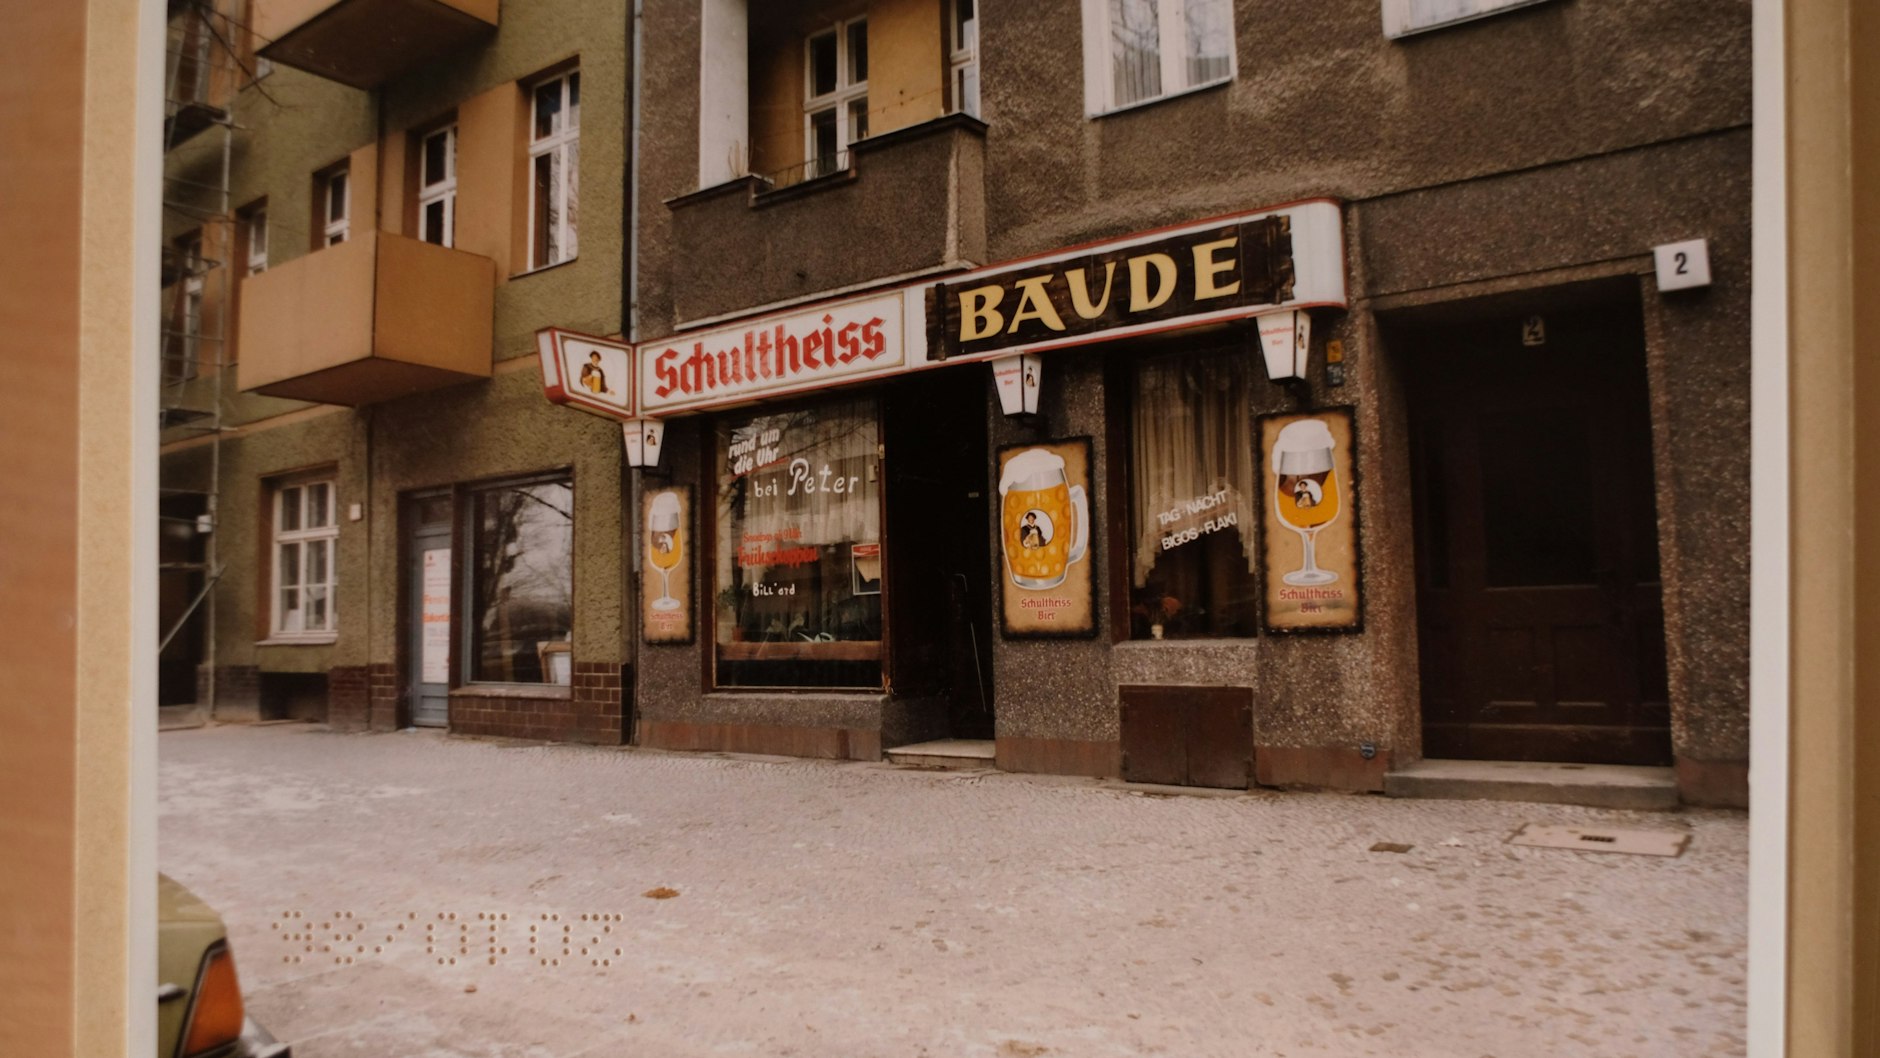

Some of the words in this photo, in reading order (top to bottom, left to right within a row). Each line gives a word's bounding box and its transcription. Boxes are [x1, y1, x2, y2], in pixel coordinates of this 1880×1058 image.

[1674, 252, 1688, 275] 2
[958, 236, 1242, 342] BAUDE
[655, 313, 887, 399] Schultheiss
[728, 434, 757, 459] rund
[760, 428, 780, 446] um
[734, 457, 753, 475] die
[756, 447, 779, 467] Uhr
[754, 478, 777, 497] bei
[787, 458, 859, 496] Peter
[1021, 598, 1072, 608] Schultheiss
[1279, 588, 1343, 600] Schultheiss
[1037, 611, 1056, 620] Bier
